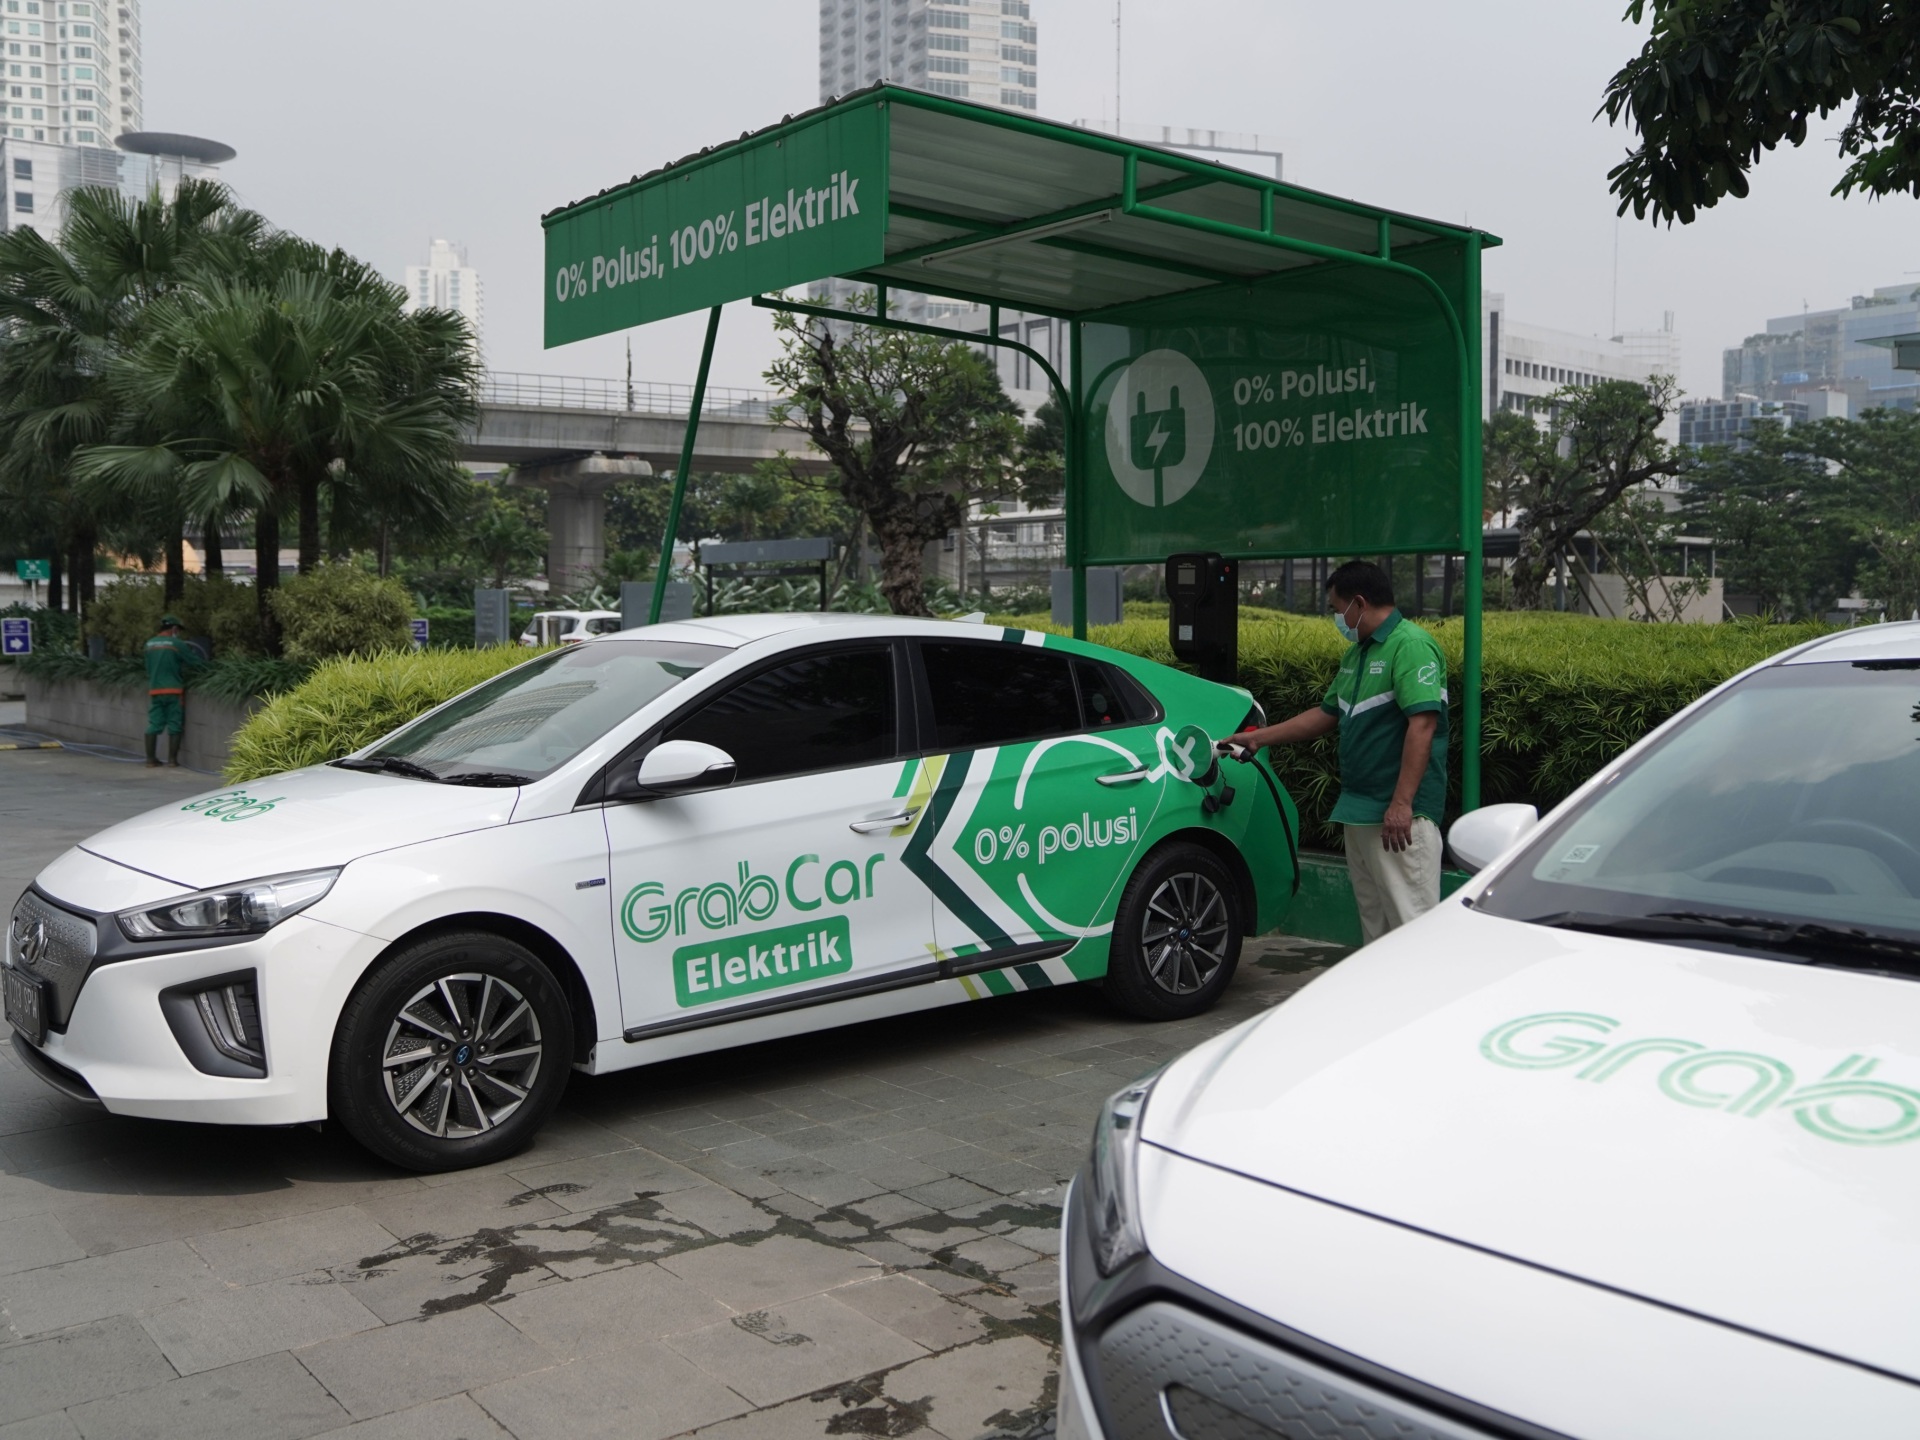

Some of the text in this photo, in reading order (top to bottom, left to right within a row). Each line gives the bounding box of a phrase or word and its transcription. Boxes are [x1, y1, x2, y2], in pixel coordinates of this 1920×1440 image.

[556, 170, 860, 302] 0% Polusi, 100% Elektrik
[1233, 359, 1376, 406] 0% Polusi,
[1233, 402, 1428, 452] 100% Elektrik
[181, 790, 287, 822] Grab
[973, 807, 1138, 865] 0% polusi
[686, 930, 843, 993] Elektrik
[1478, 1011, 1920, 1147] Grab
